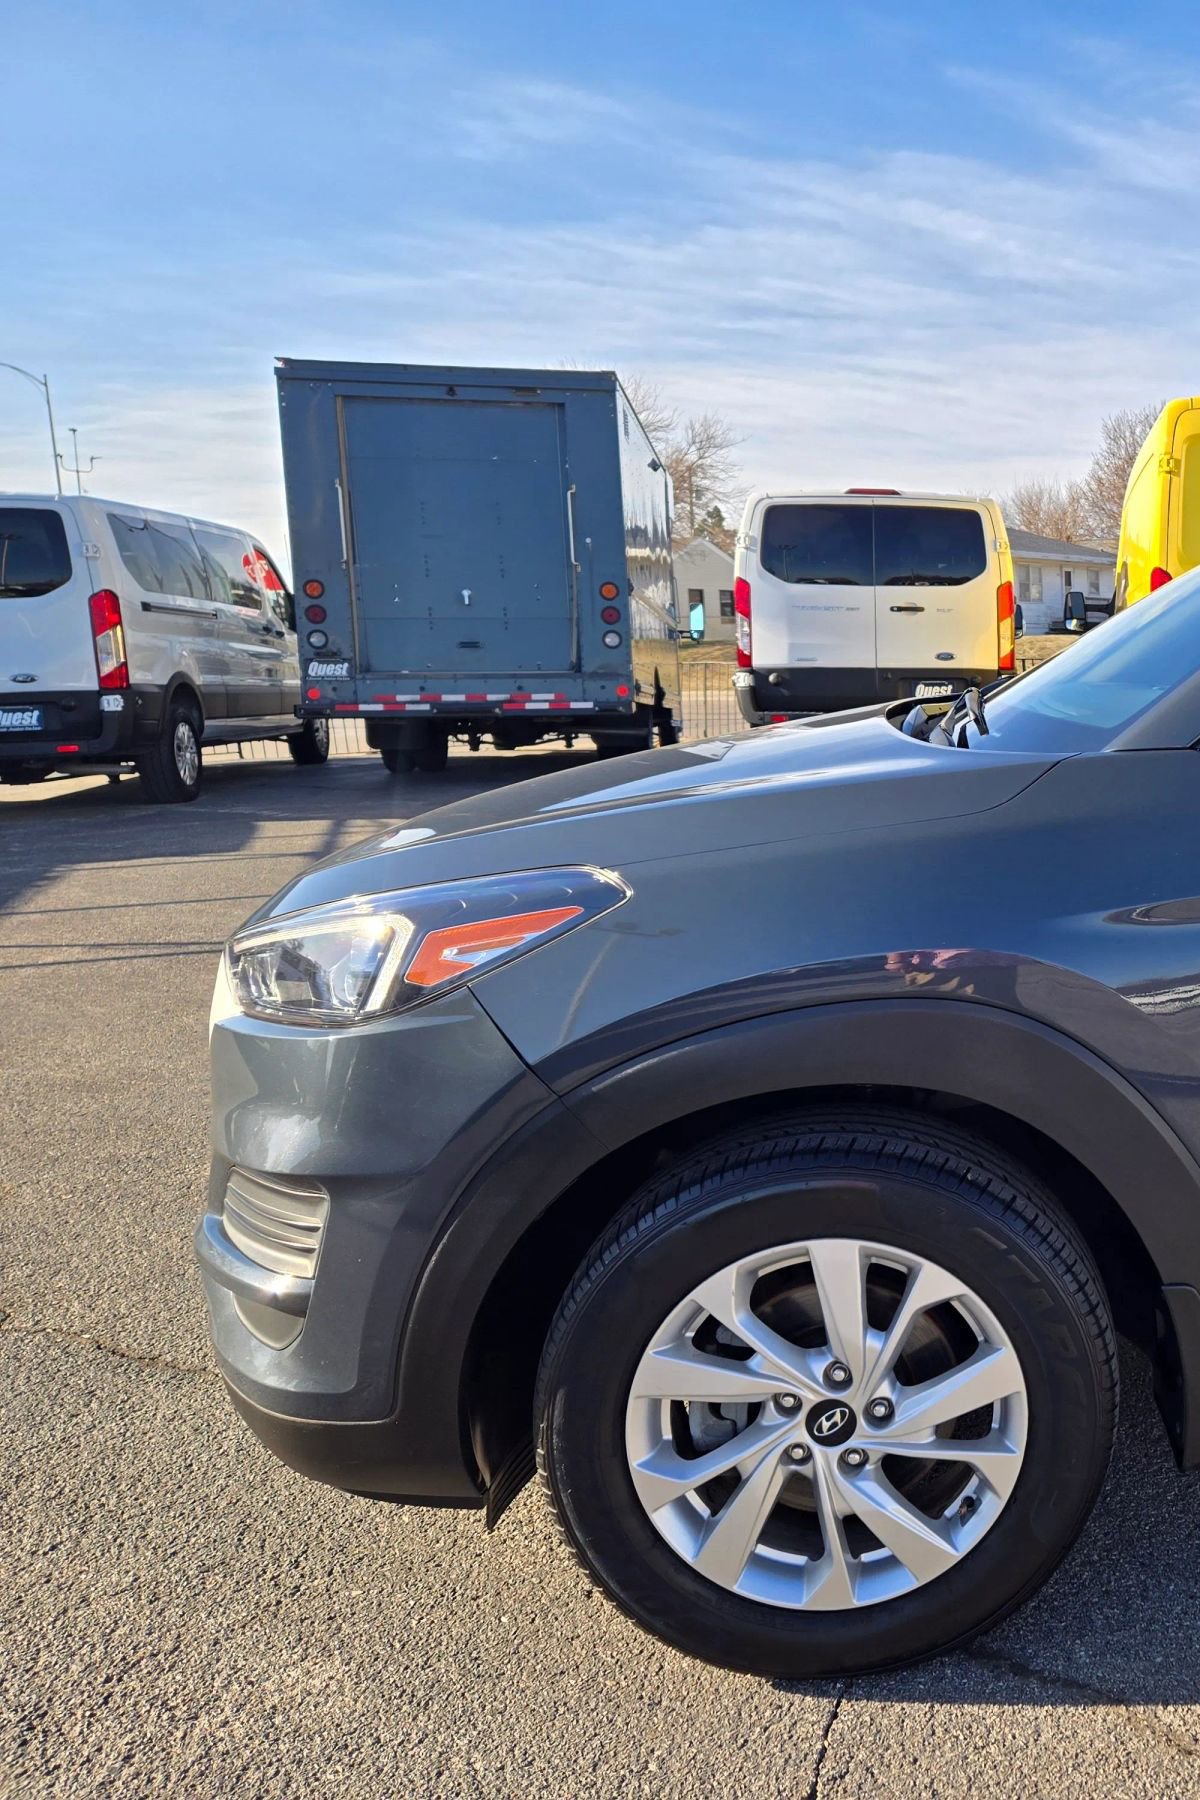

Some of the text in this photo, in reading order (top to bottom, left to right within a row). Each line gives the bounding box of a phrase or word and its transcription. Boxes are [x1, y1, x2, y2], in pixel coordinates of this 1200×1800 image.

[308, 661, 349, 677] Quest
[915, 684, 953, 698] Quest
[0, 709, 40, 727] uest
